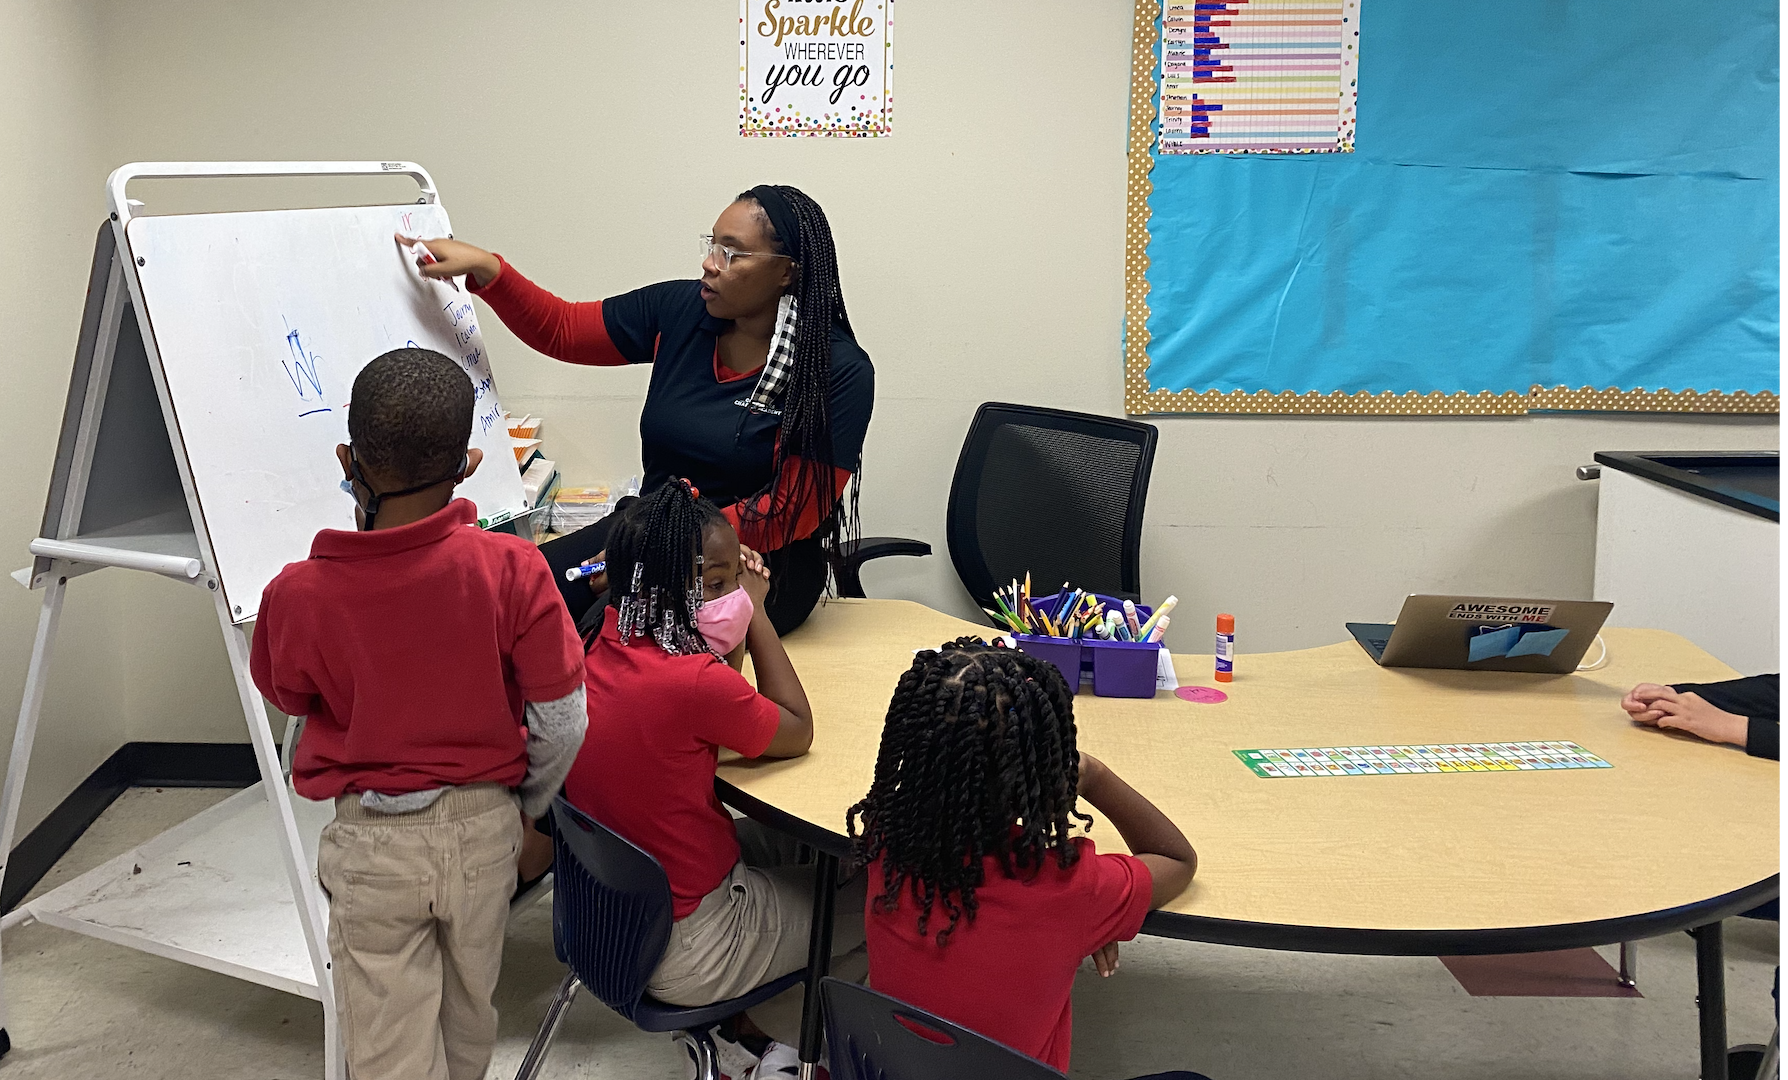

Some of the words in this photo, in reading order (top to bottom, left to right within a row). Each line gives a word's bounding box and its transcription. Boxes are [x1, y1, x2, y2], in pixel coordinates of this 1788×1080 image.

[757, 0, 875, 47] Sparkle
[784, 42, 865, 60] WHEREVER
[761, 64, 825, 104] you
[829, 64, 871, 105] go
[480, 402, 501, 436] Amir
[1453, 604, 1551, 615] AWESOME
